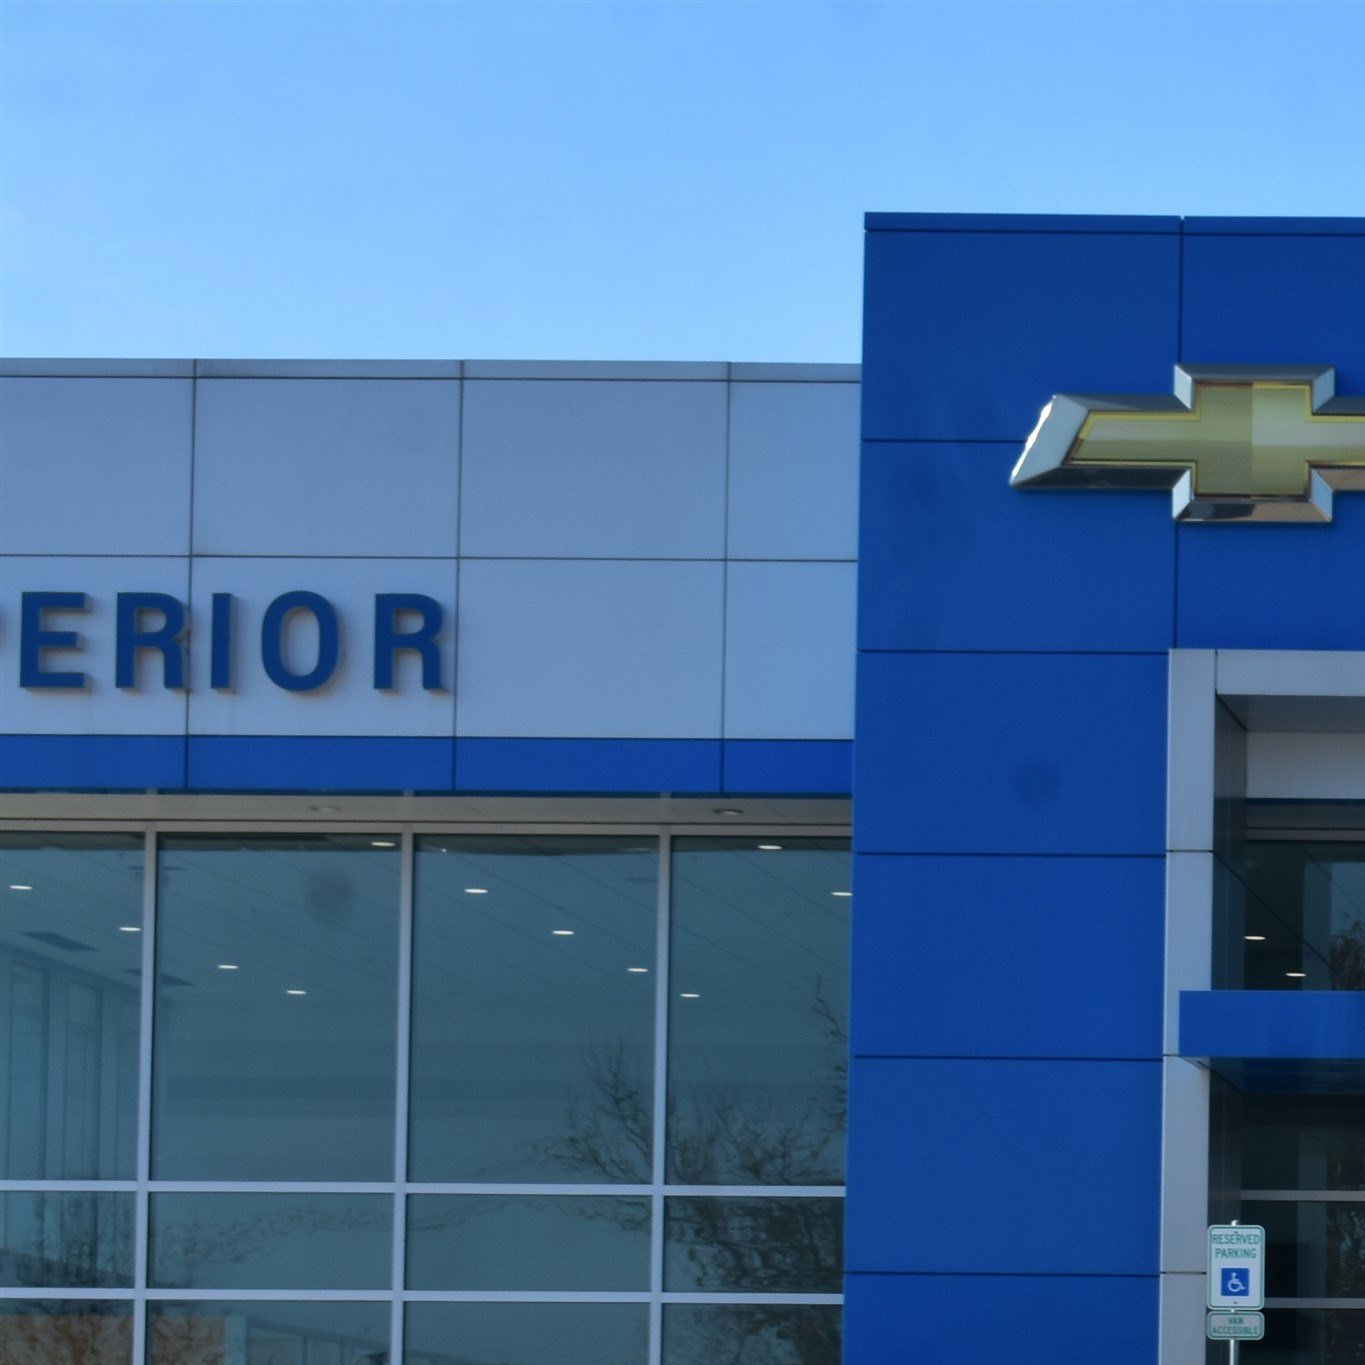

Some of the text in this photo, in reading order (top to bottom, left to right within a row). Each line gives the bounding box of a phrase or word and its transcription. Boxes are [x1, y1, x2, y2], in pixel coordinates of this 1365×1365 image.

[0, 589, 448, 693] ERIOR
[1211, 1233, 1260, 1245] RESERVED
[1215, 1248, 1257, 1259] PARKING
[1228, 1317, 1244, 1325] VAN
[1212, 1326, 1259, 1335] ACCESSIBLE
